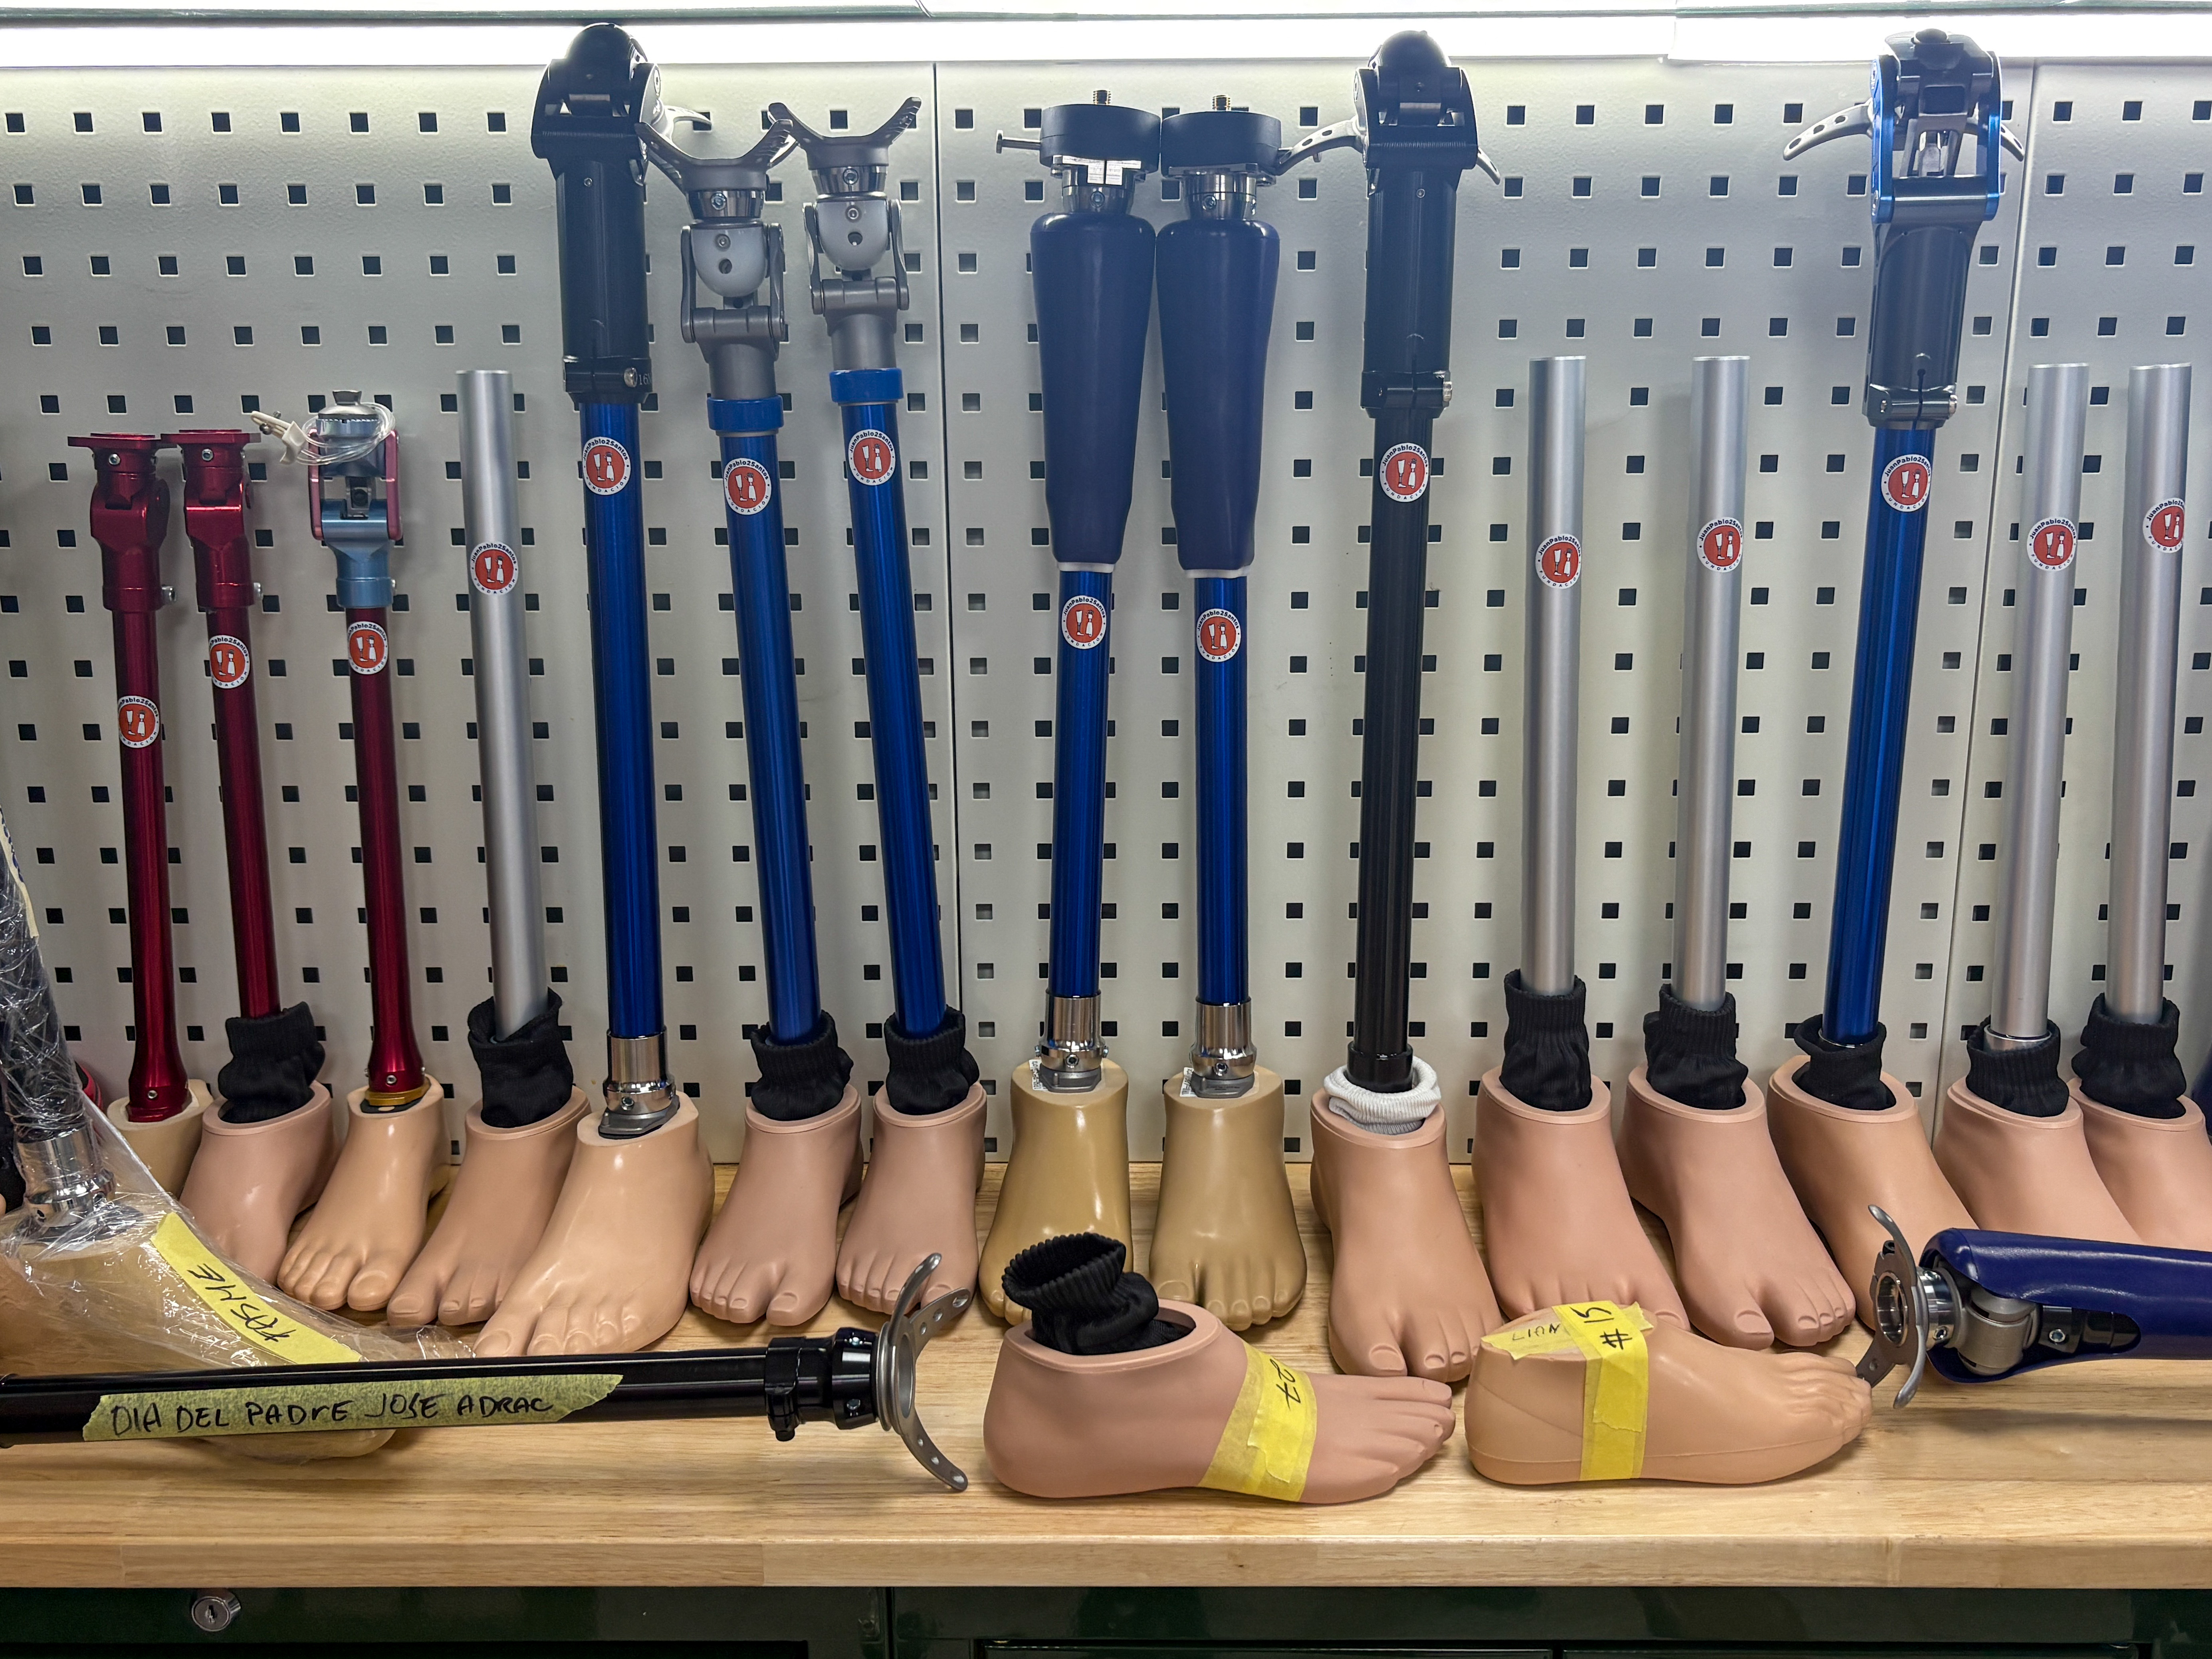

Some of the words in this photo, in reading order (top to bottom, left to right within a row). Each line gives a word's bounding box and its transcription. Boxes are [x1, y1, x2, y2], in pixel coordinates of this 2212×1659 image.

[111, 1402, 162, 1435] DIA
[176, 1405, 230, 1433] DEL
[364, 1392, 447, 1419] JOSE
